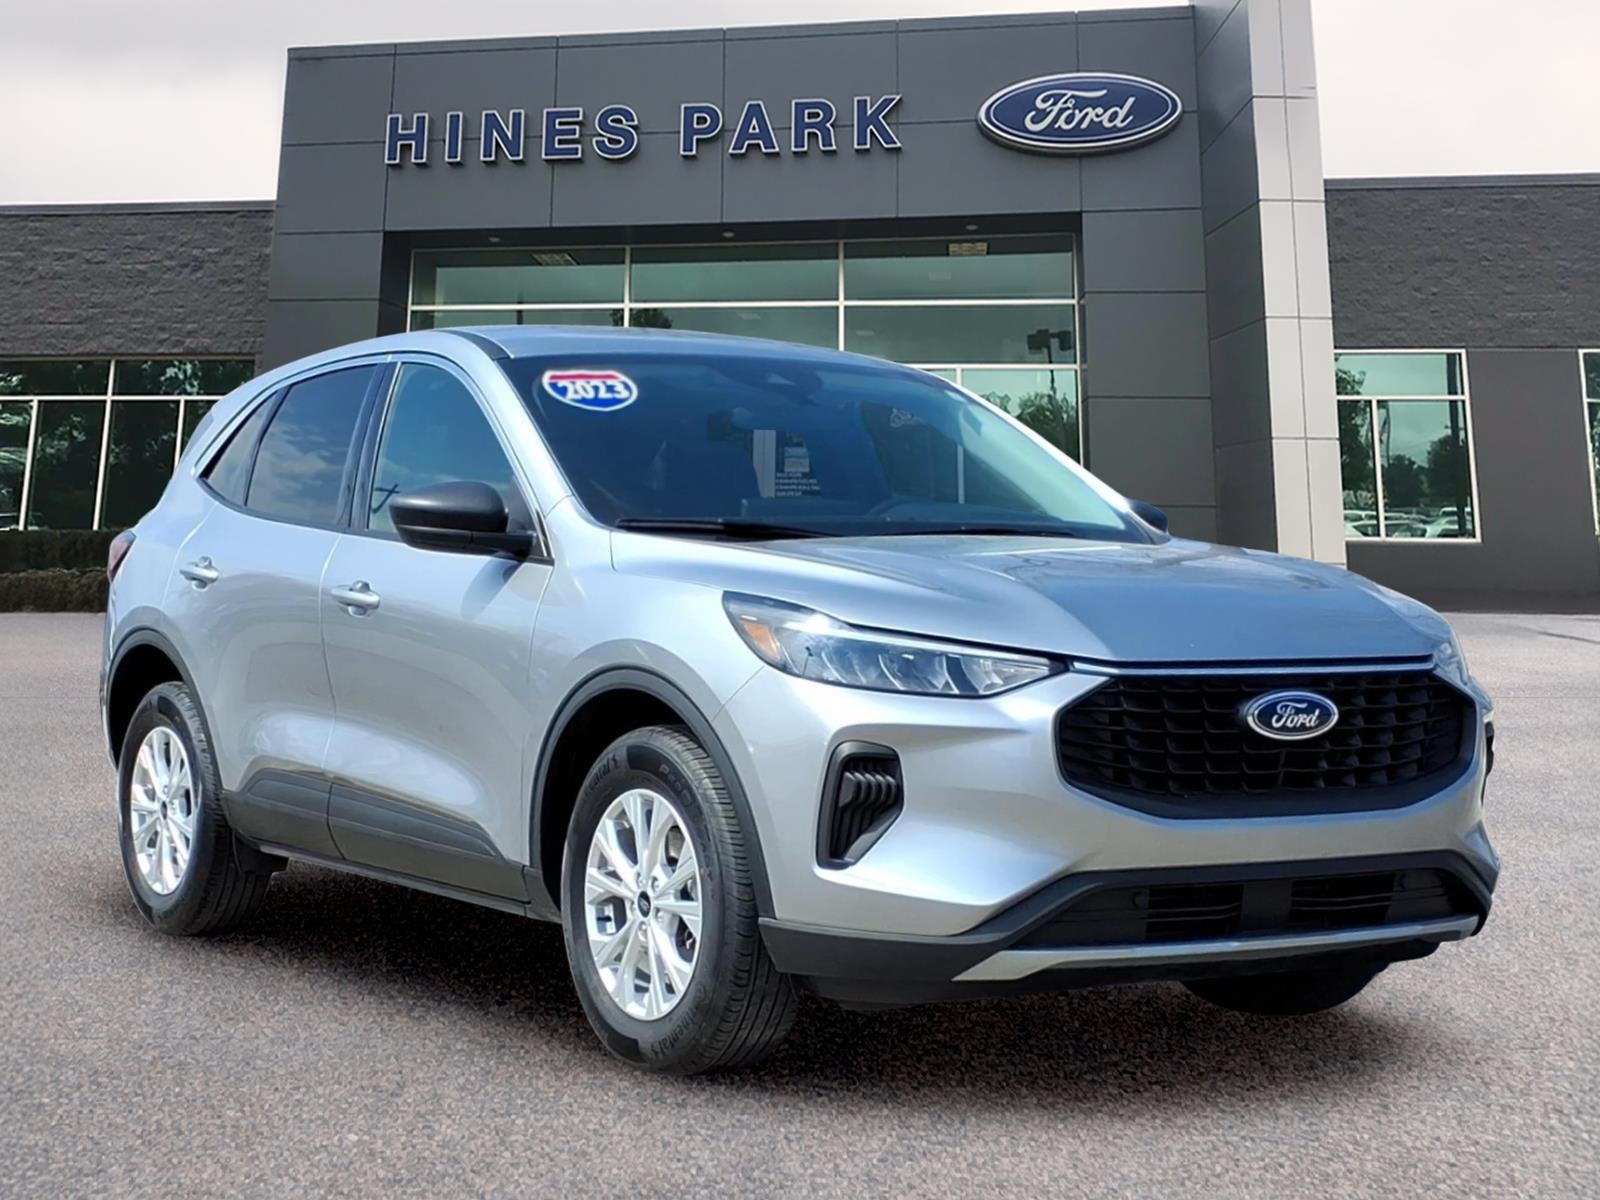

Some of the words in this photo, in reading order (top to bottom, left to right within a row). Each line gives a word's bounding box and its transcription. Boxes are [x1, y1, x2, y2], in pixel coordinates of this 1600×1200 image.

[1024, 89, 1136, 132] Ford
[384, 103, 639, 165] HINES
[679, 94, 902, 156] PARK
[556, 380, 631, 400] 2023
[1271, 701, 1320, 728] Ford
